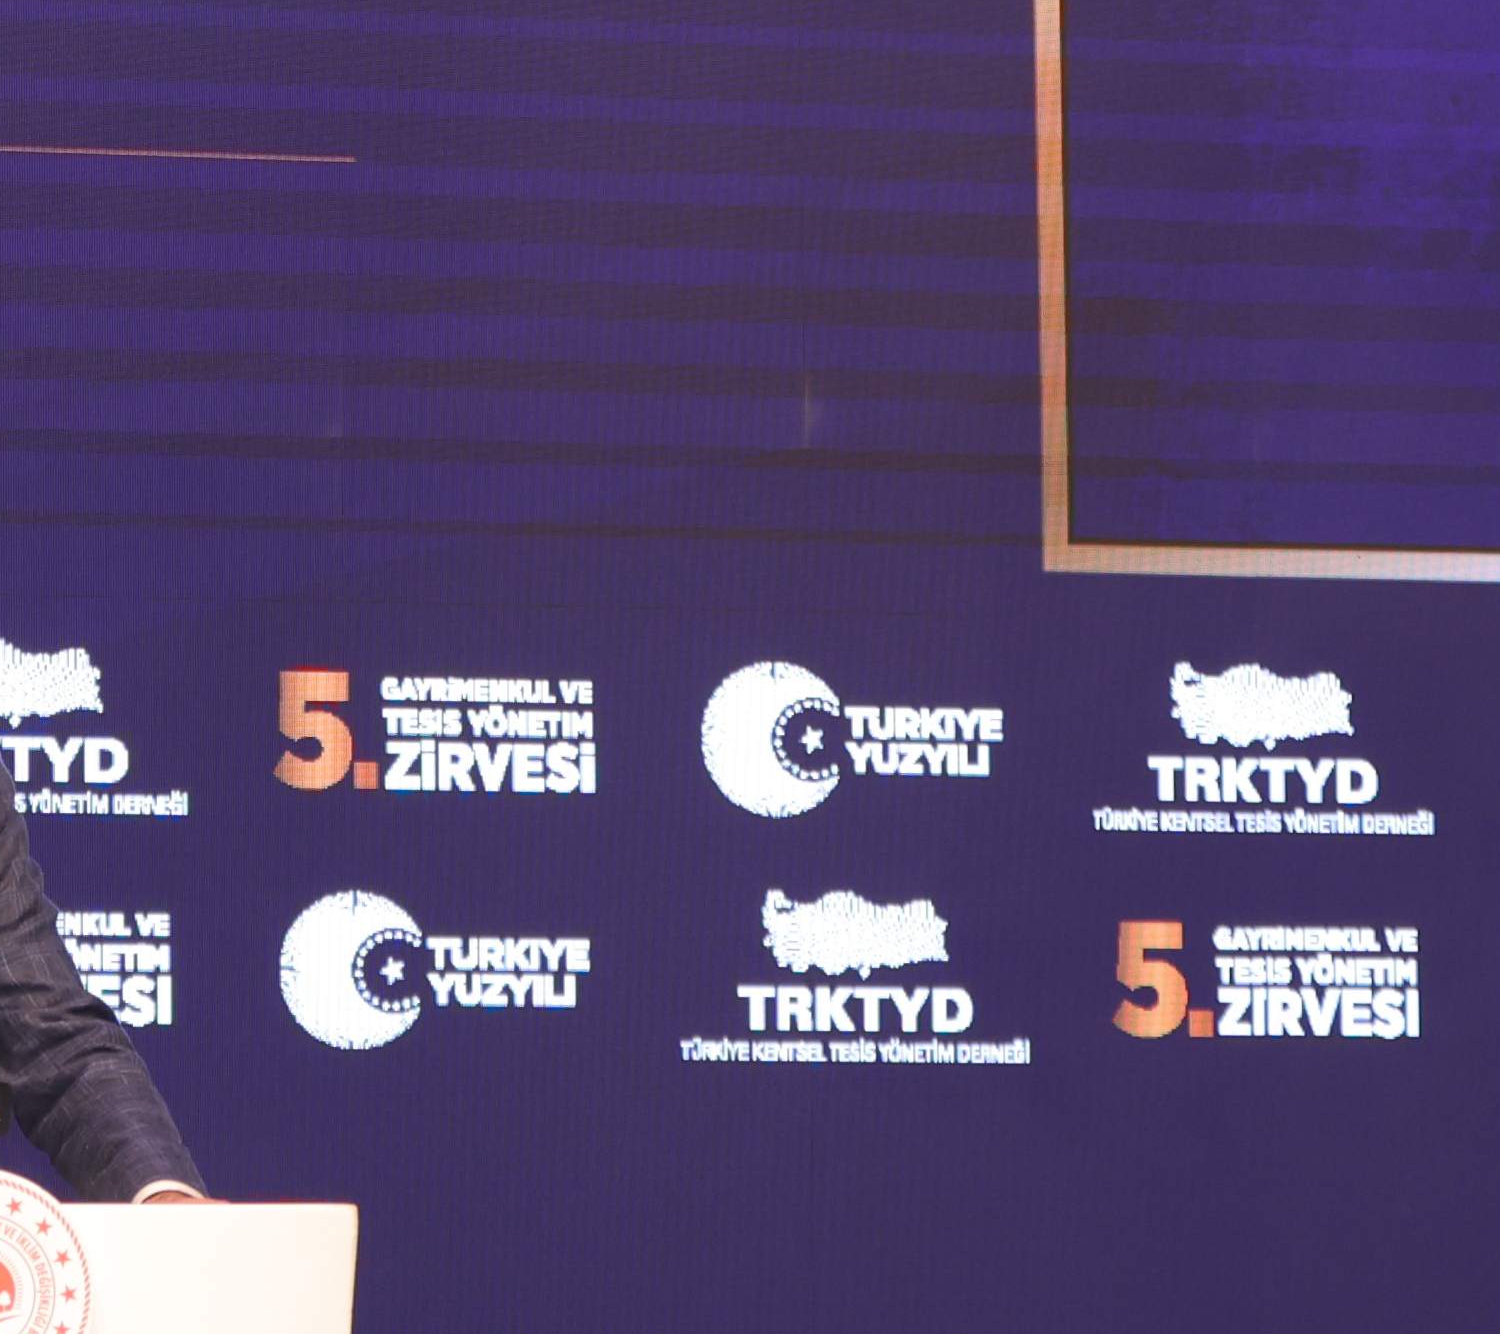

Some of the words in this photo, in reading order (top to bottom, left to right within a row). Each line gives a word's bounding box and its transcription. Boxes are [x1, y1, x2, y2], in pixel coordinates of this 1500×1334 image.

[560, 681, 593, 705] VE
[274, 665, 379, 791] 5.
[1149, 757, 1379, 805] TRKTYD
[134, 912, 171, 937] VE
[1386, 929, 1419, 953] VE
[1113, 920, 1214, 1038] 5.
[738, 989, 974, 1033] TRKTYD
[3, 1224, 18, 1240] VE
